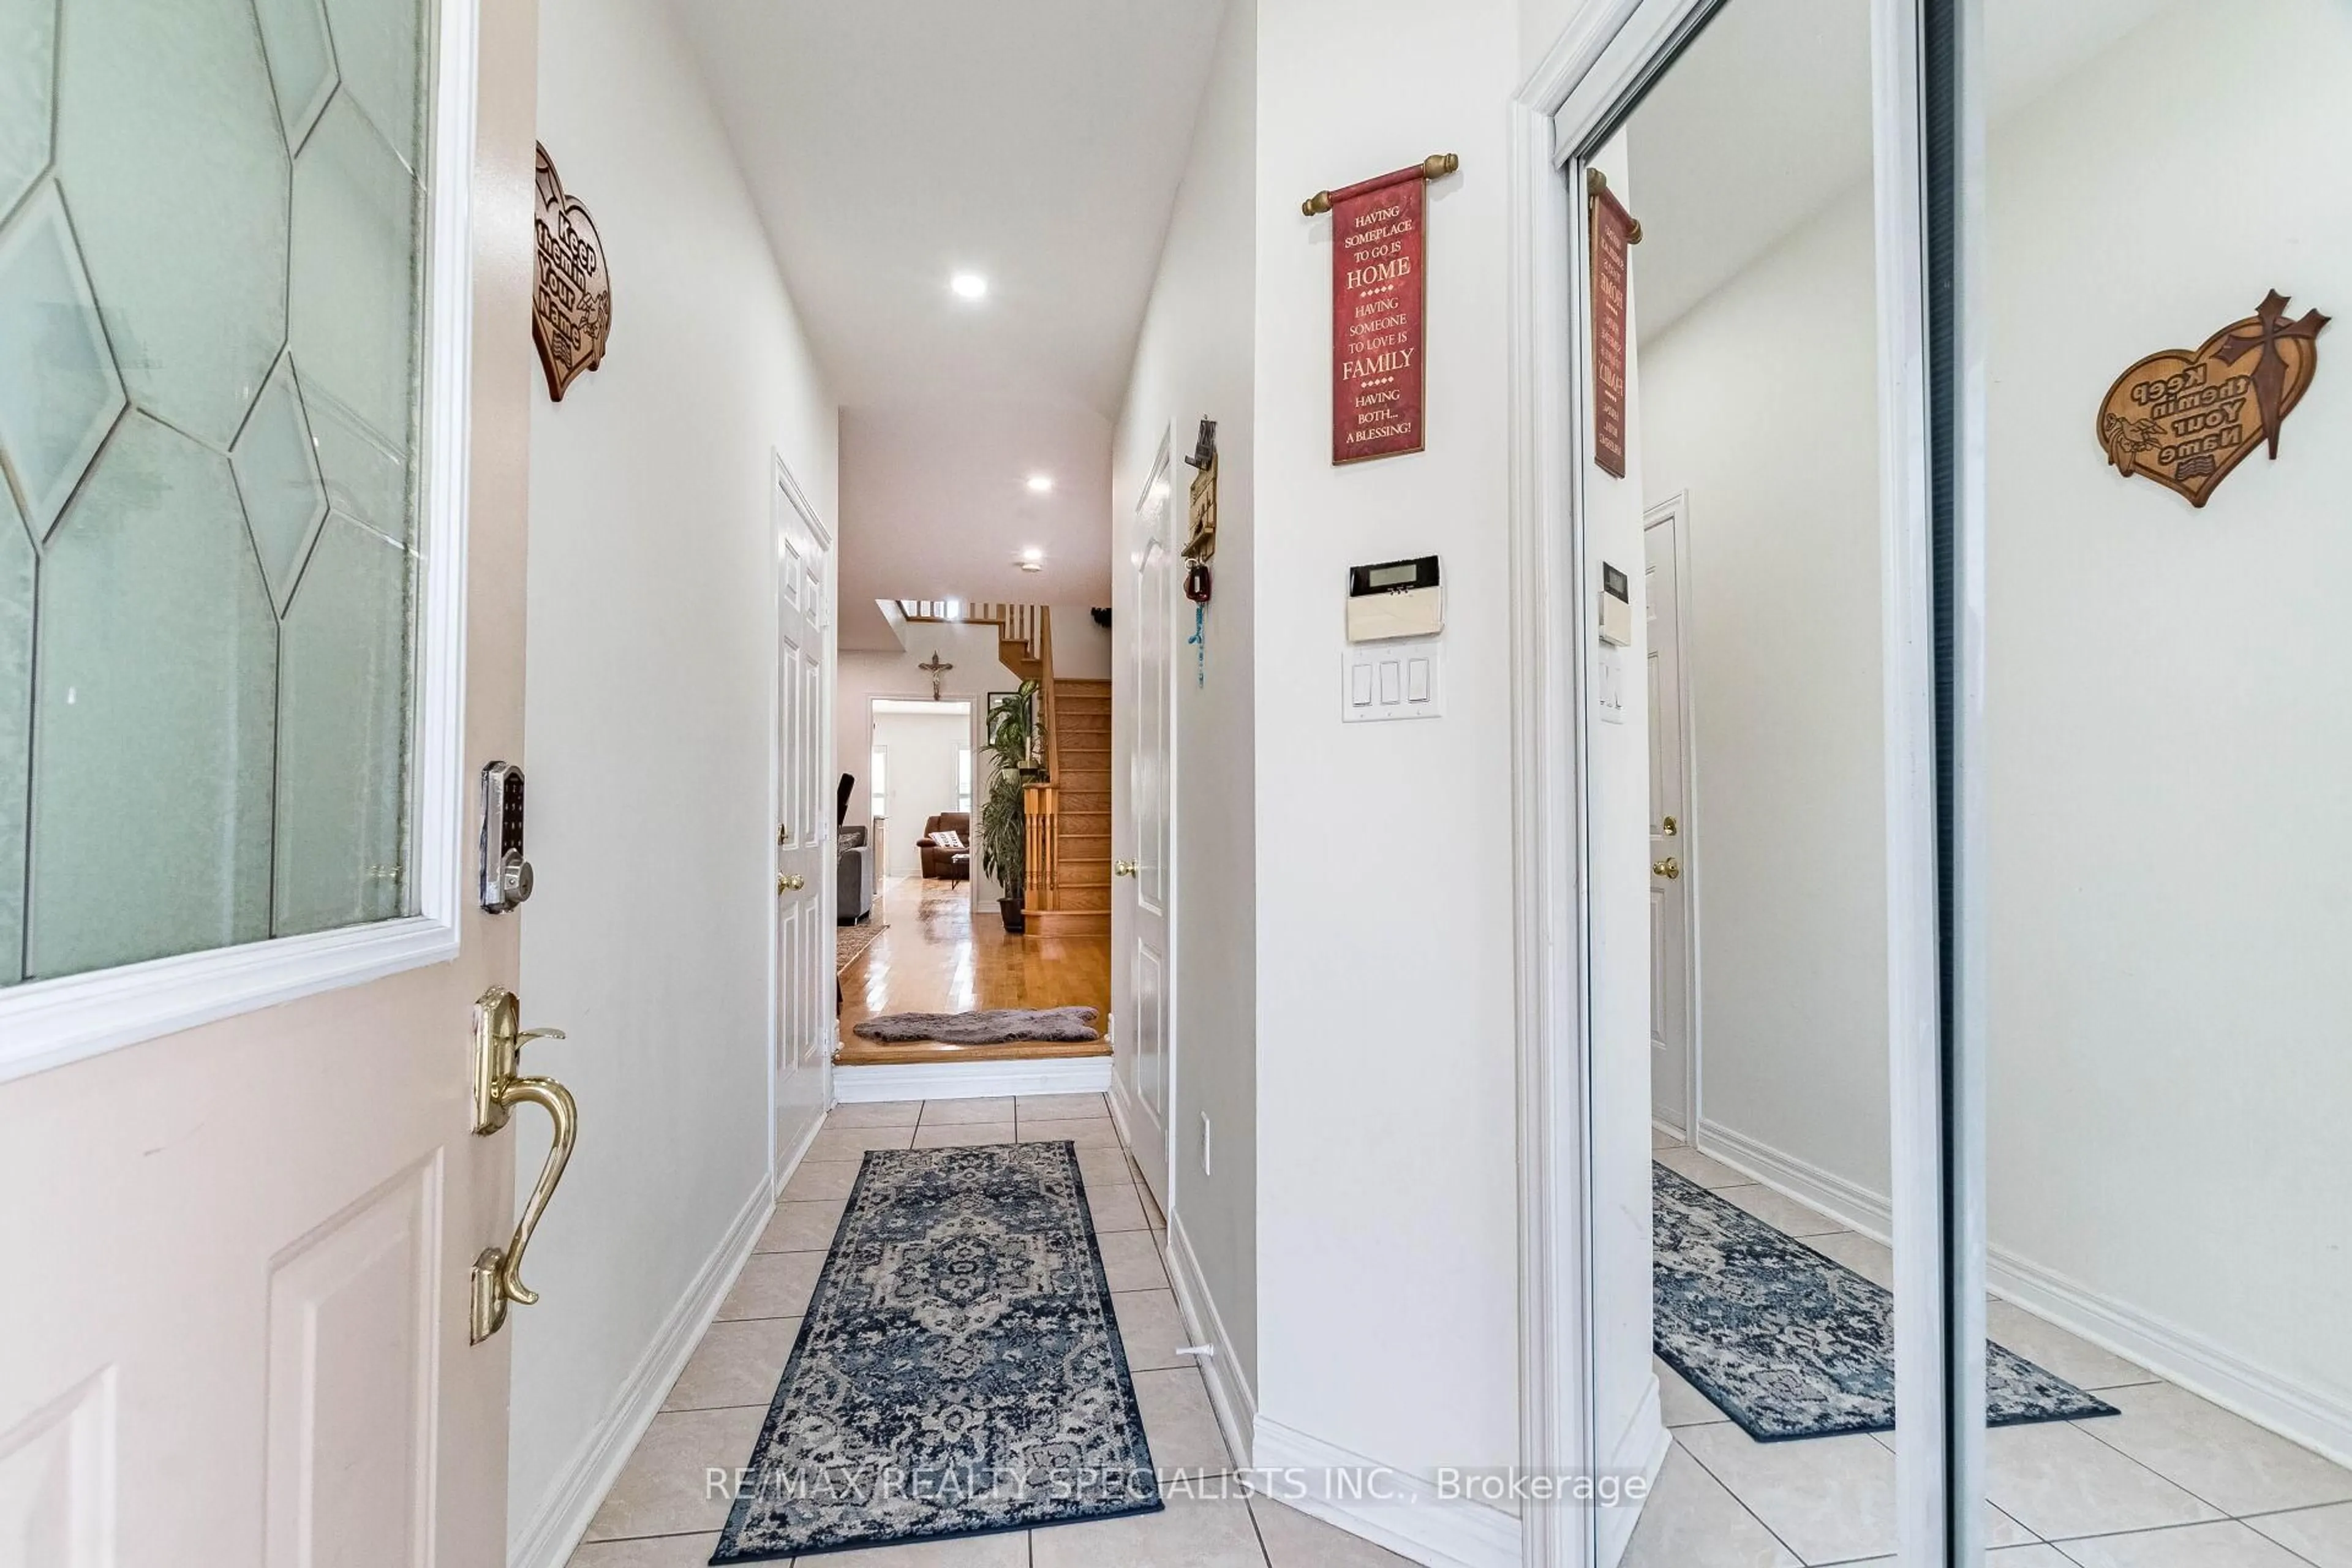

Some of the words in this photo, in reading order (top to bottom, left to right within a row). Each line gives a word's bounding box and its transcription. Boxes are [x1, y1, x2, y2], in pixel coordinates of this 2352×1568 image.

[1355, 206, 1400, 227] HAVING
[559, 213, 595, 274] Keep
[1344, 219, 1412, 248] SOMEPLACE
[1354, 250, 1370, 263] TO
[1372, 245, 1389, 258] GO
[1391, 241, 1401, 253] IS
[538, 252, 575, 311] Your
[1347, 256, 1411, 290] HOME
[540, 288, 580, 349] Name
[1355, 298, 1399, 318] HAVING
[1349, 314, 1408, 336] SOMEONE
[1349, 342, 1364, 354] TO
[1366, 334, 1395, 350] LOVE
[1398, 331, 1408, 344] IS
[1343, 347, 1415, 380] FAMILY
[1355, 390, 1400, 407] HAVING
[1358, 409, 1398, 424] BOTH...
[1346, 432, 1354, 443] A
[1355, 422, 1411, 442] BLESSING!
